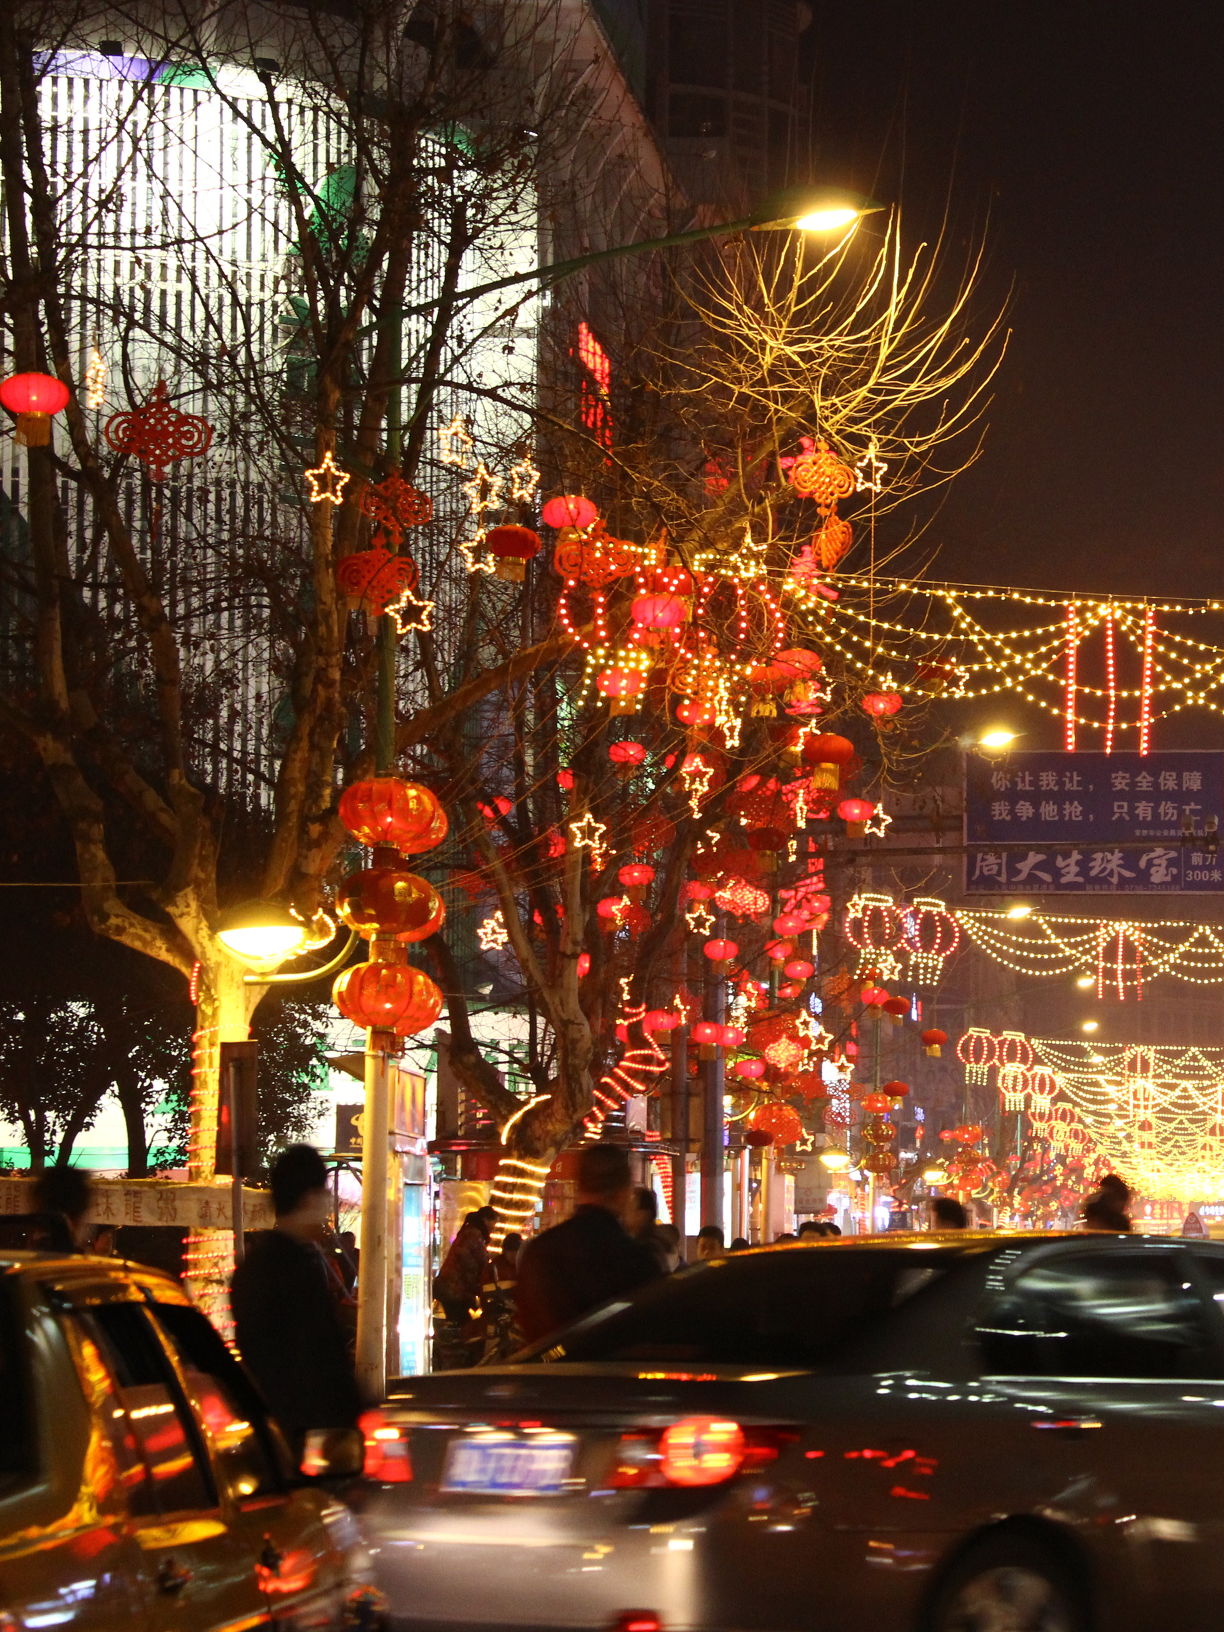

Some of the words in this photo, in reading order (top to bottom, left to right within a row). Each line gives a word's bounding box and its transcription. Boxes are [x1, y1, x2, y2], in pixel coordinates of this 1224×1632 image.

[971, 847, 1179, 885] 周大生珠宝
[1185, 869, 1223, 882] 300米
